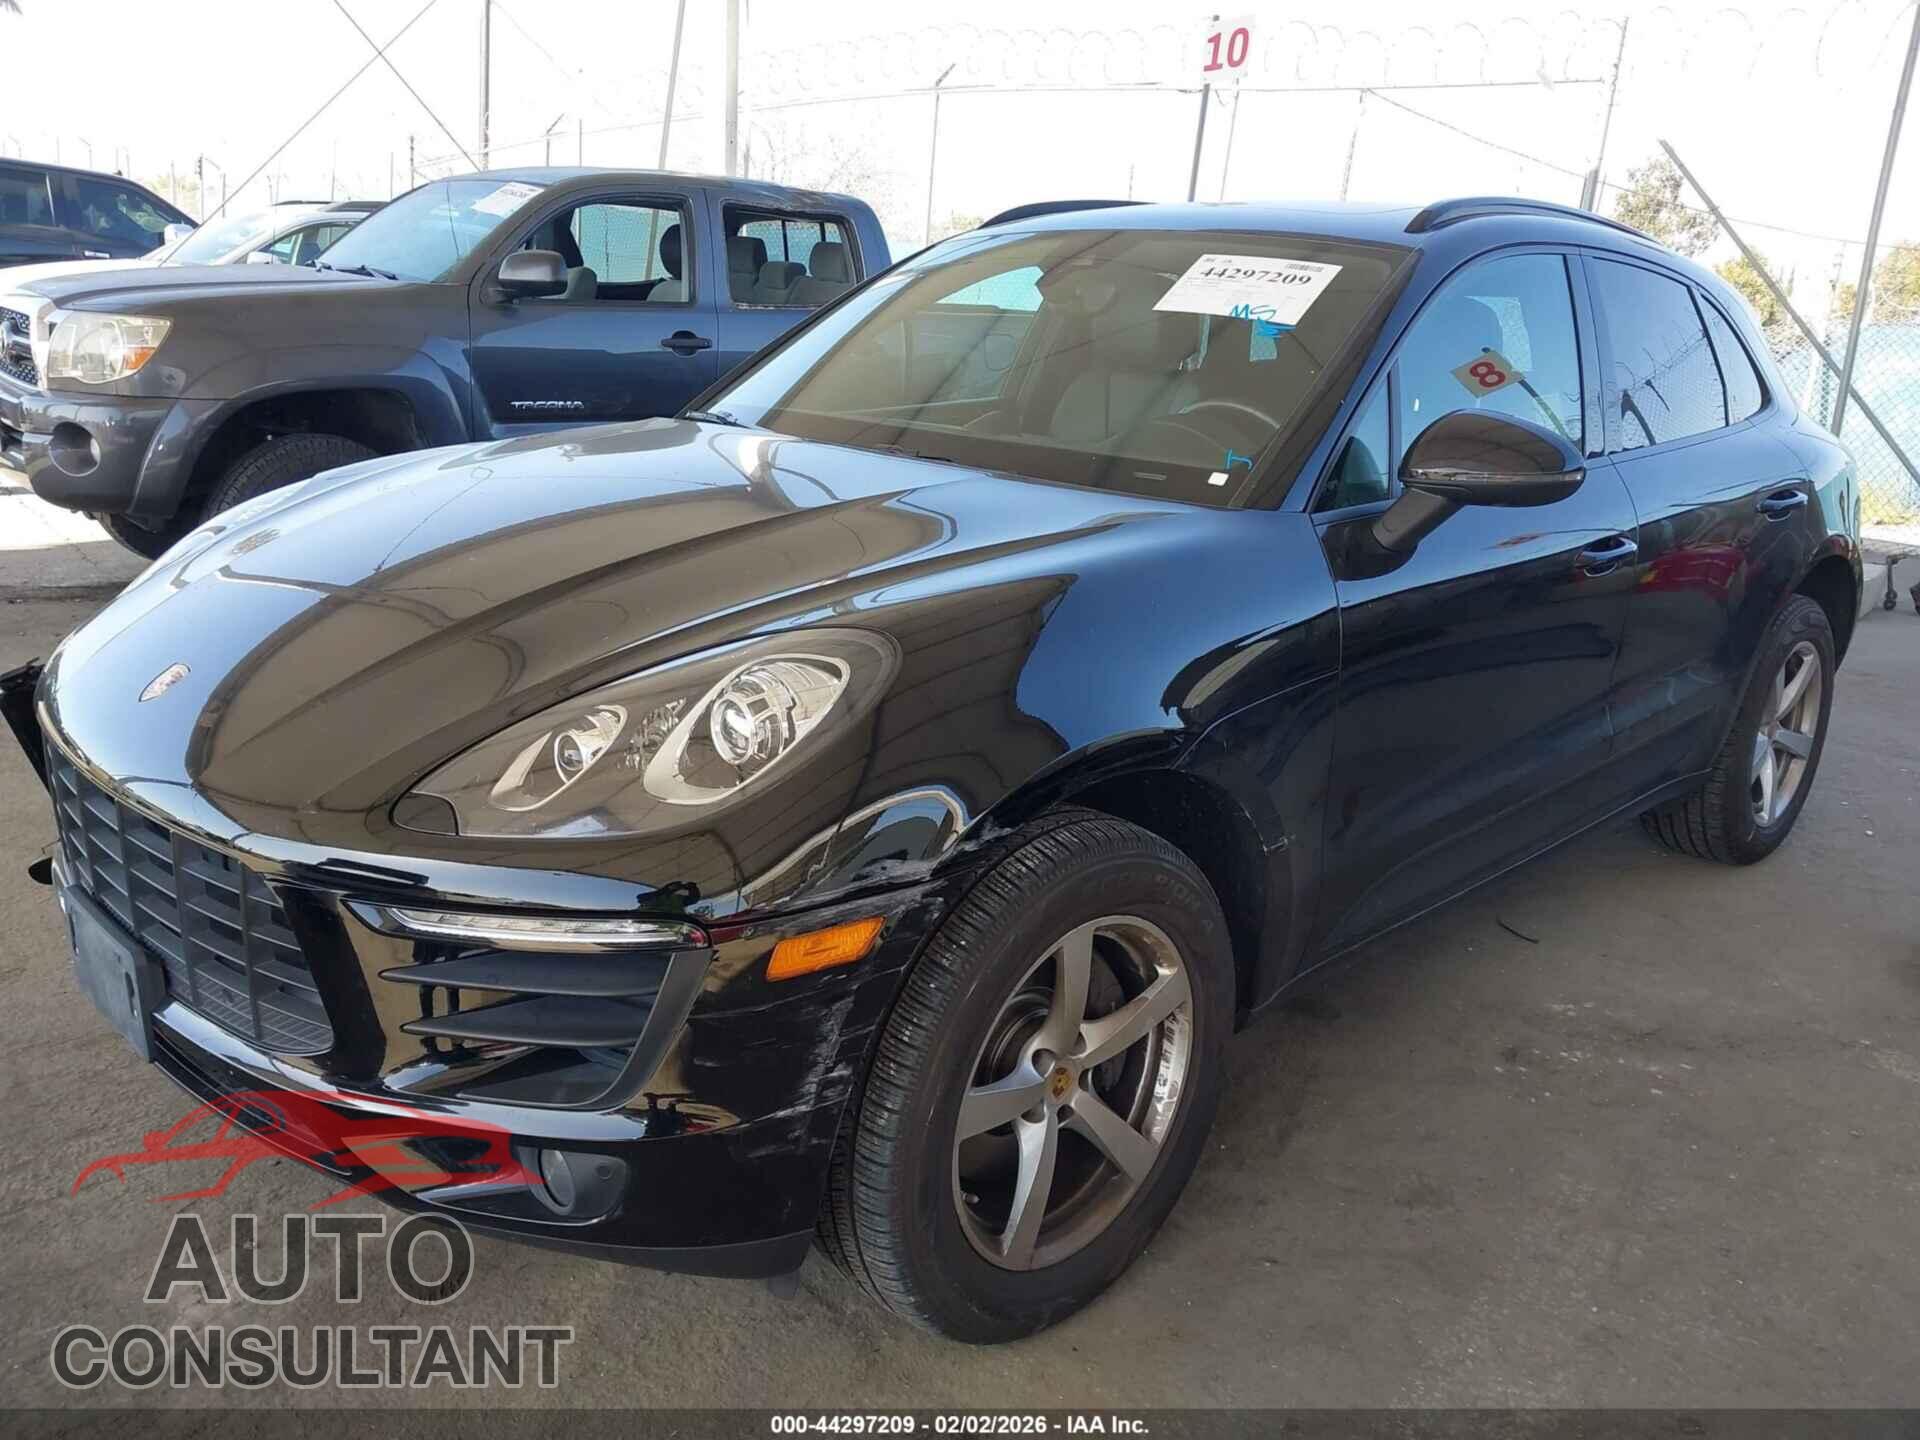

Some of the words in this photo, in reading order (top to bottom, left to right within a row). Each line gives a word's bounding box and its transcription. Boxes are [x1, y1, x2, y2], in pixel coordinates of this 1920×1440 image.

[1204, 27, 1249, 71] 10
[1200, 266, 1312, 284] 44297209
[1469, 361, 1506, 388] 8
[511, 401, 585, 409] TACOMA
